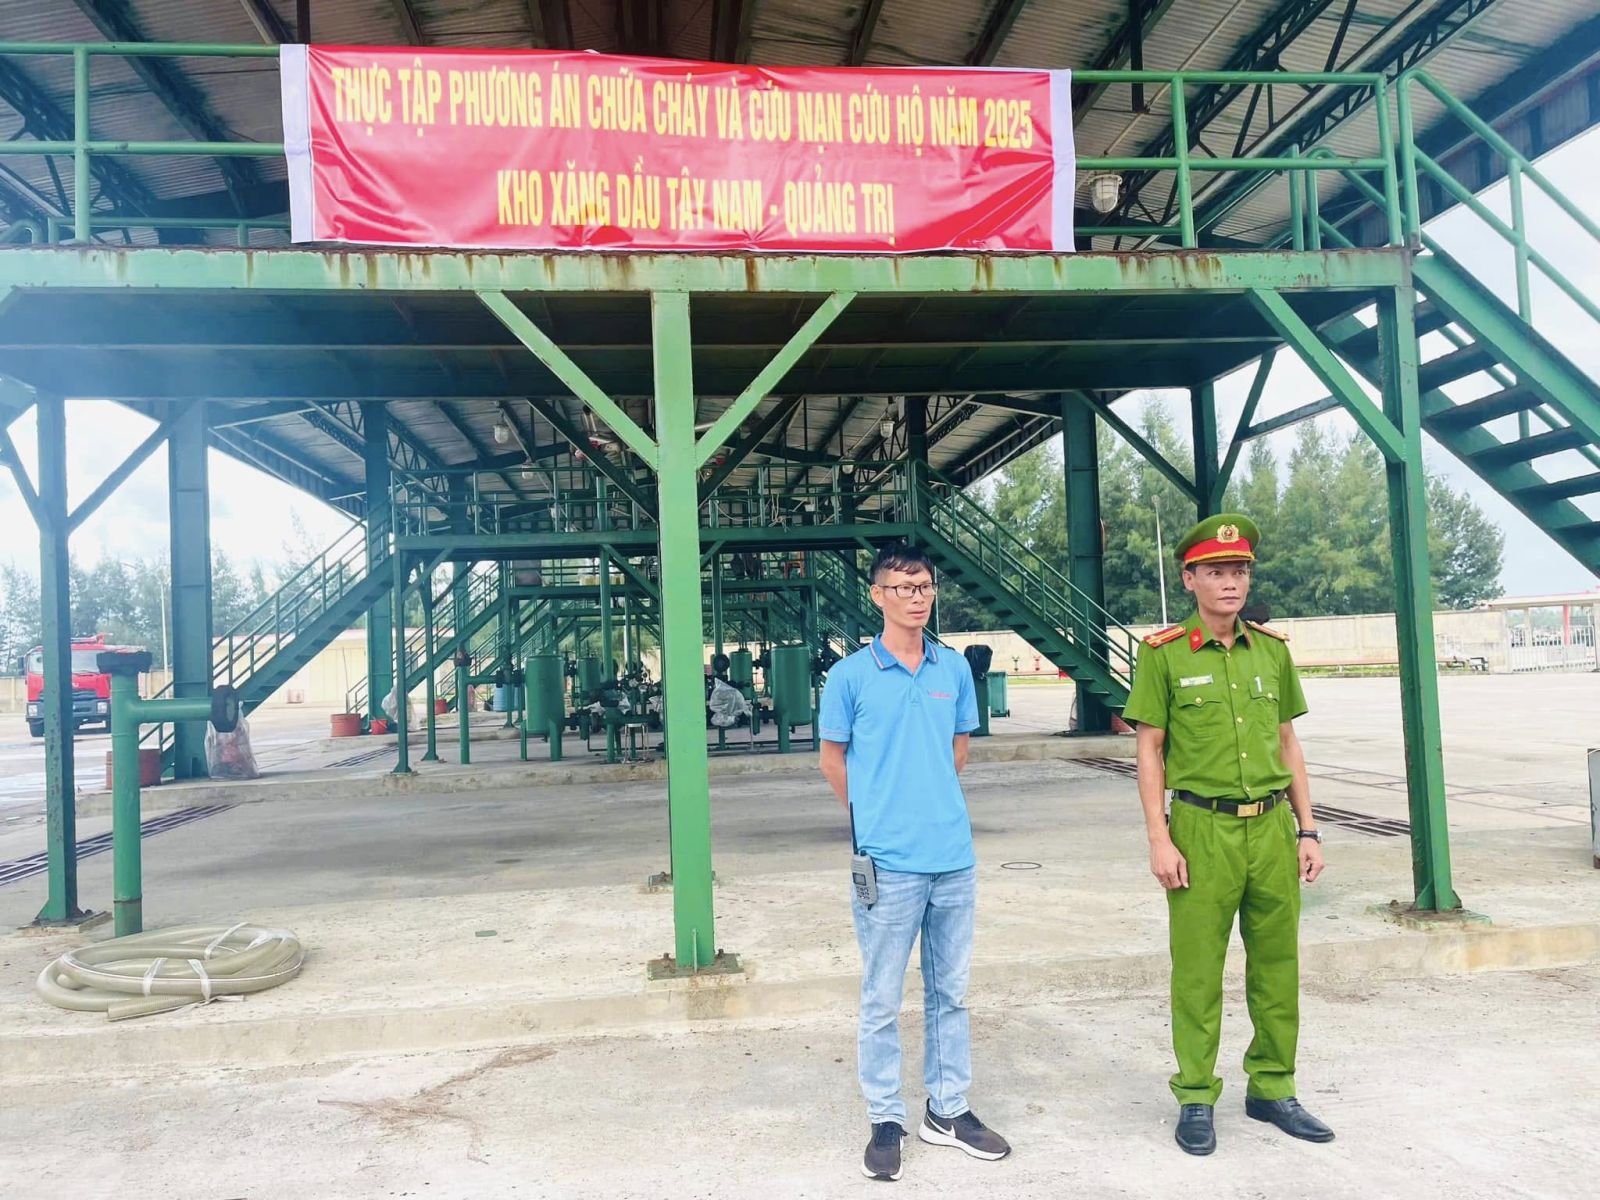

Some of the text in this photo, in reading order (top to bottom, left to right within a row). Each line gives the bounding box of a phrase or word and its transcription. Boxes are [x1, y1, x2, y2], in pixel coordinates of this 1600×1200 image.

[332, 60, 1033, 156] THỰC TẬP PHƯƠNG ÁN CHỮA CHÁY VÀ CỨU NẠN CỨU HỘ NĂM 2025
[497, 169, 544, 226] KHO
[550, 160, 610, 228] XĂNG
[617, 155, 661, 230] DẦU
[667, 166, 706, 231] TÂY
[712, 179, 763, 231] NAM
[784, 164, 857, 238] QUẢNG
[861, 183, 896, 246] TRỊ
